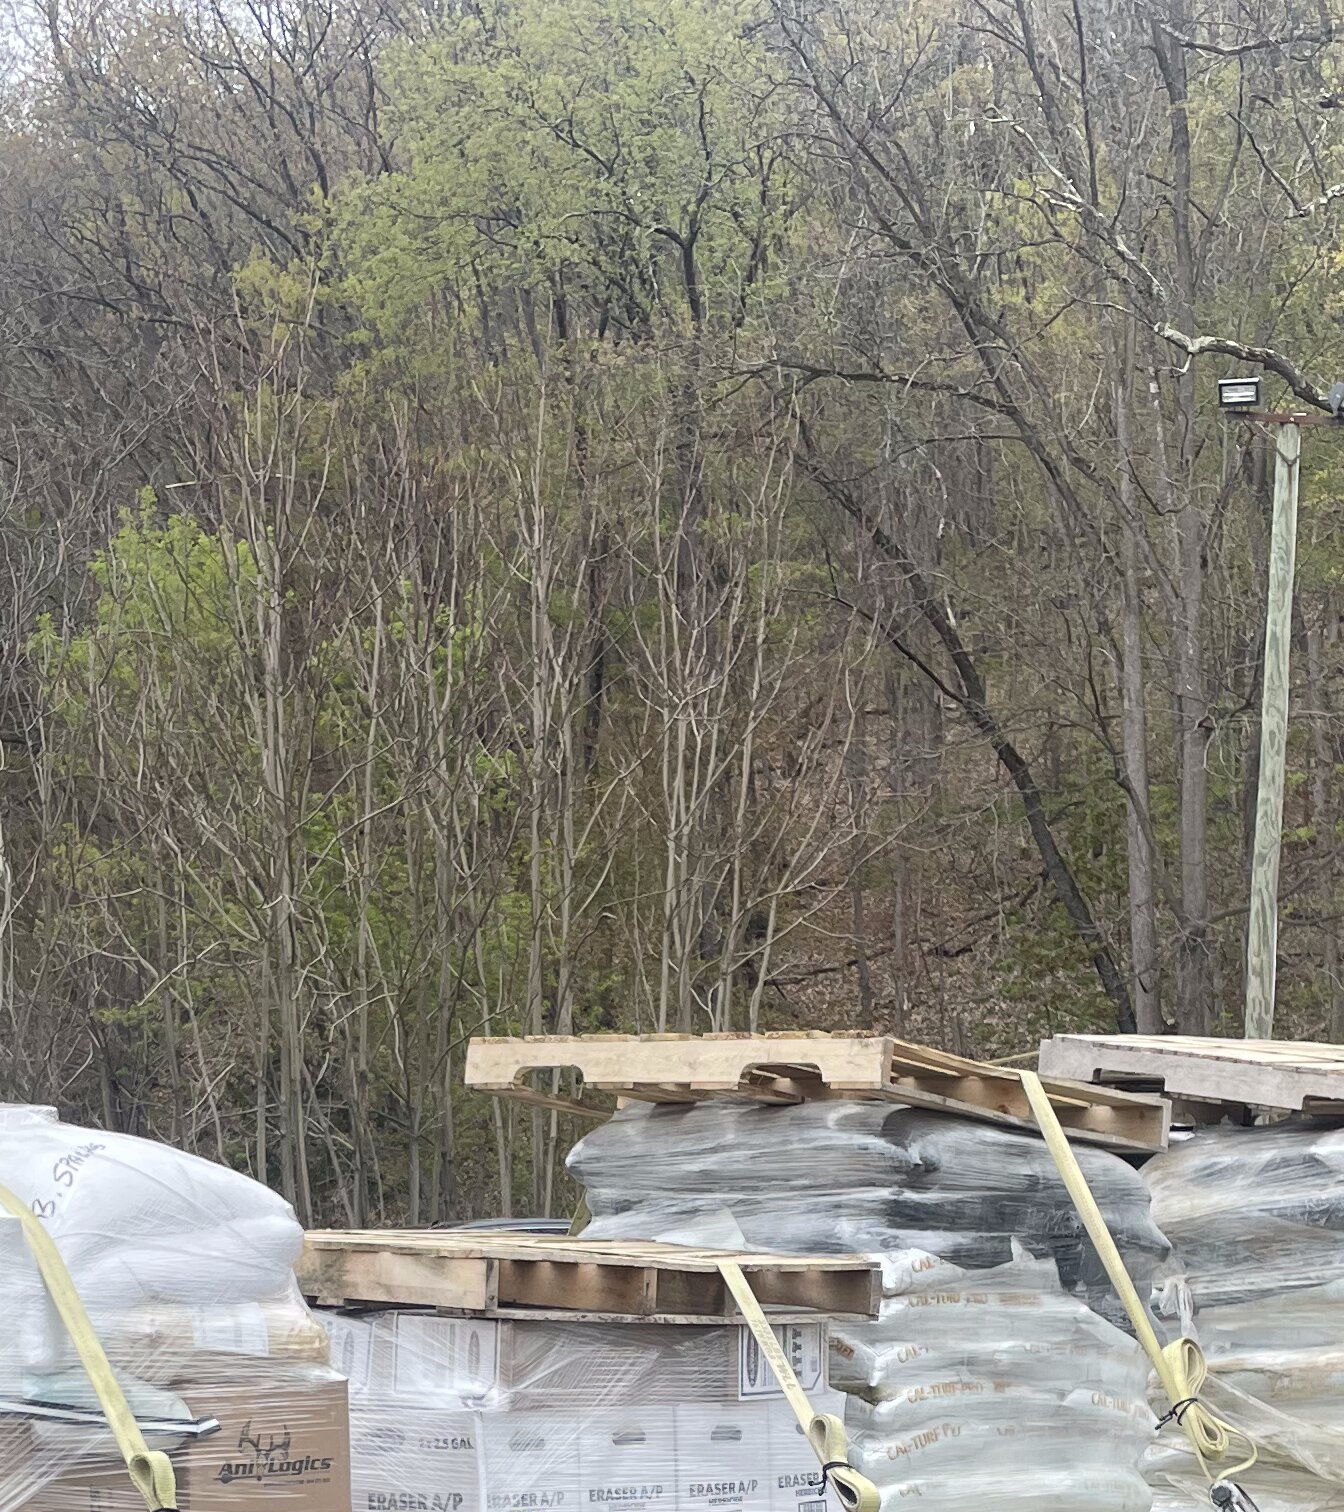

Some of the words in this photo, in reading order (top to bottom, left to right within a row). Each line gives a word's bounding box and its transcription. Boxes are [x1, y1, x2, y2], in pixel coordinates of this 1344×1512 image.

[886, 1426, 942, 1461] CAL-TURF
[267, 1456, 332, 1475] Logics
[689, 1482, 738, 1498] ERASER
[738, 1479, 759, 1495] A/P
[777, 1472, 820, 1489] ERASER
[368, 1493, 428, 1511] ERASER
[431, 1493, 463, 1512] A/P
[486, 1492, 539, 1509] ERASER
[540, 1490, 565, 1508] A/P
[588, 1488, 638, 1502] ERASER
